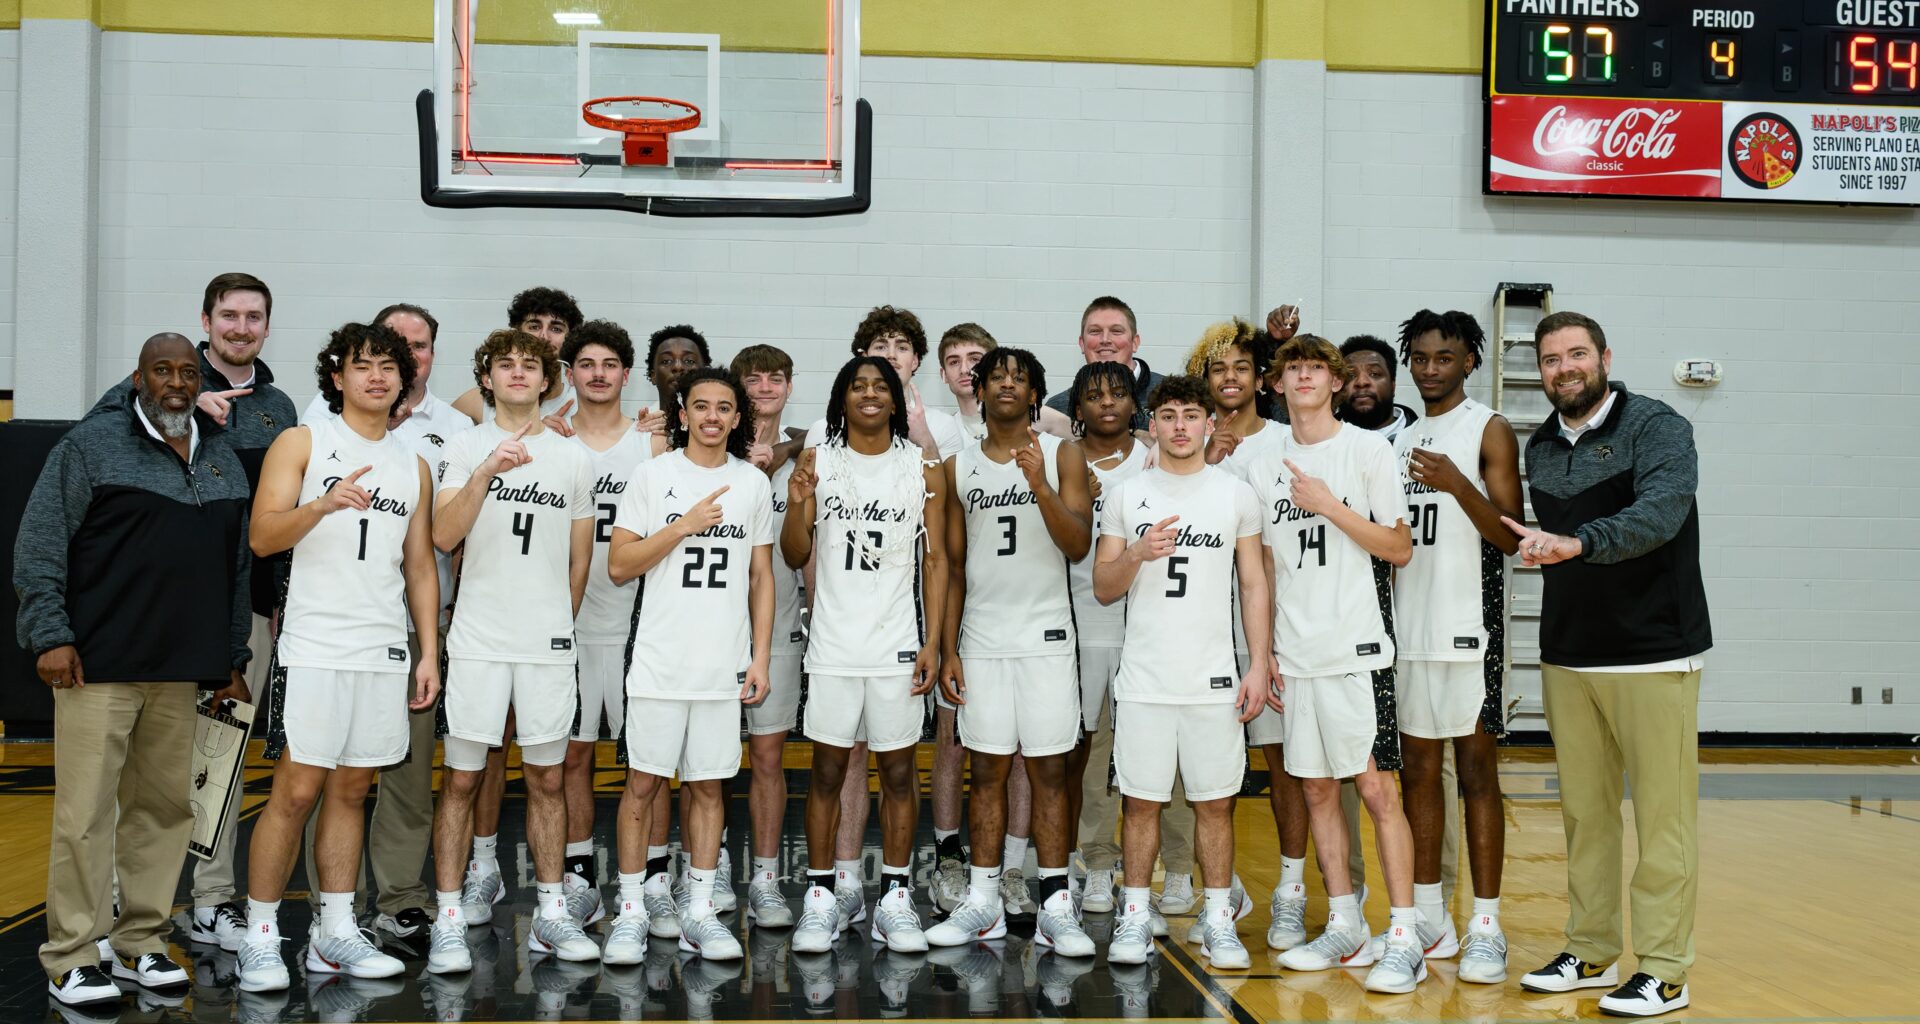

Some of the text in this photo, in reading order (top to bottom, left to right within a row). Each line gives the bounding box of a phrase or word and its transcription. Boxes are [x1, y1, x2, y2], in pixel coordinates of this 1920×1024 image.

[1507, 0, 1640, 18] PANTHERS
[1692, 9, 1755, 29] PERIOD
[1543, 25, 1613, 82] 57
[1652, 62, 1662, 78] B
[1711, 40, 1735, 78] 4
[1850, 36, 1919, 92] 54
[1782, 66, 1793, 82] B
[1532, 105, 1682, 160] Coca-Cola
[1736, 120, 1795, 161] NAPOLI'S
[1811, 114, 1920, 134] NAPOLI'S PIZ
[1812, 155, 1871, 171] STUDENTS
[1874, 156, 1898, 171] AND
[1813, 136, 1862, 152] SERVING
[1865, 137, 1902, 153] PLANO
[1586, 159, 1624, 172] classic
[1840, 174, 1907, 190] SINCE 1997
[486, 475, 567, 509] Panthers
[967, 484, 1038, 514] Panther
[358, 518, 369, 561] 1
[512, 512, 534, 555] 4
[997, 515, 1017, 556] 3
[1408, 503, 1438, 546] 20
[1297, 524, 1326, 569] 14
[682, 547, 728, 588] 22
[1165, 556, 1189, 598] 5
